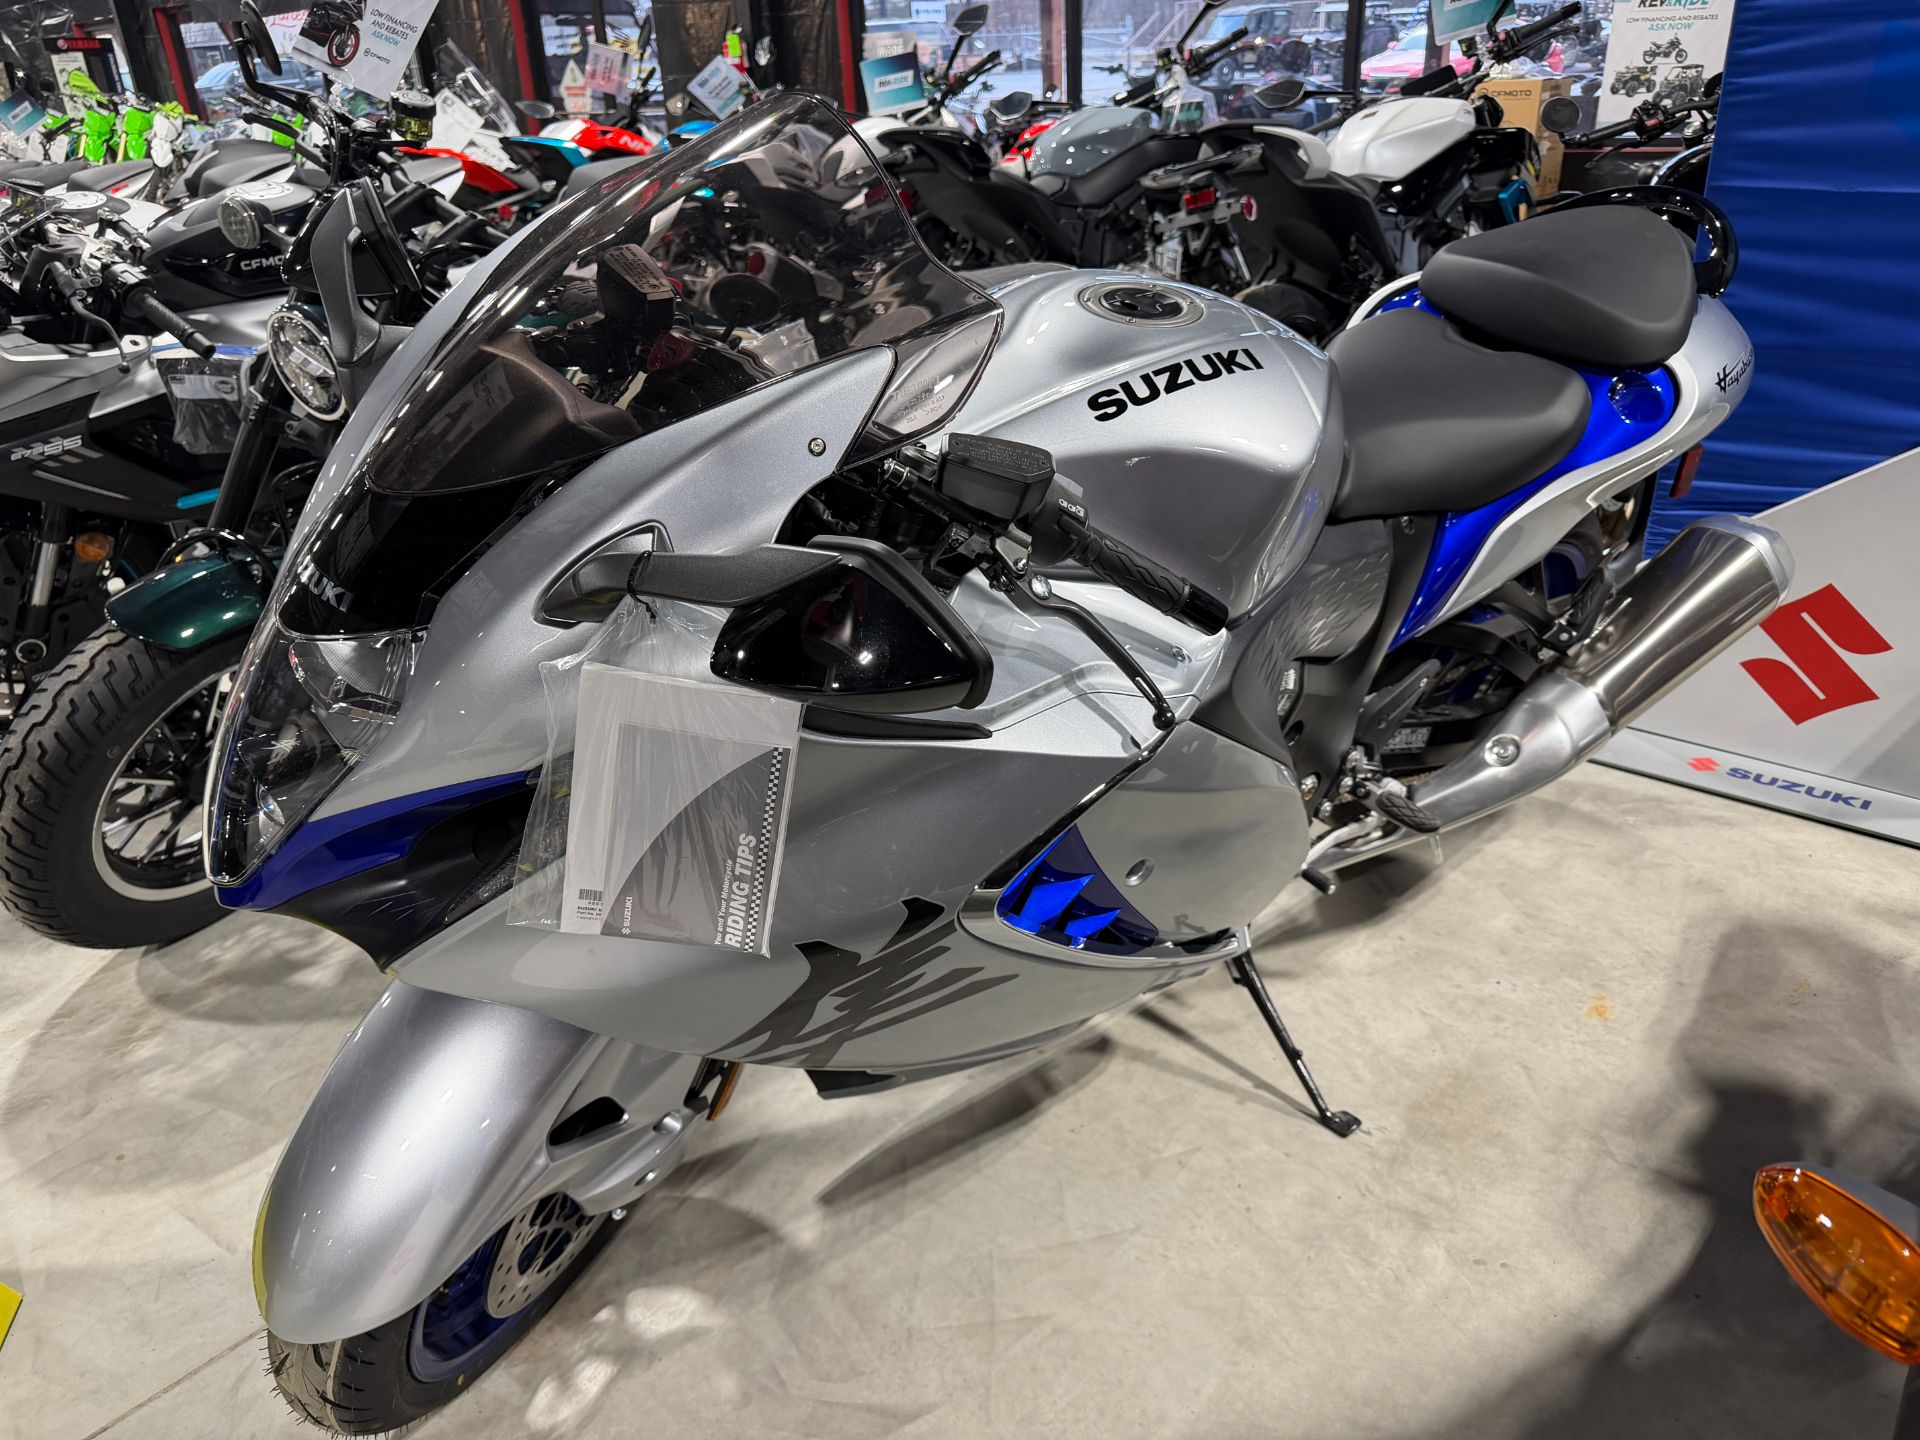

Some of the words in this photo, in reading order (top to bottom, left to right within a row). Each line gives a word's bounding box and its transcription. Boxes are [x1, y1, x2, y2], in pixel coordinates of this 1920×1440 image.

[370, 8, 385, 18] LOW
[385, 14, 418, 33] FINANCING
[371, 20, 385, 29] AND
[385, 25, 409, 40] REBATES
[1648, 23, 1665, 31] ASK
[1667, 22, 1693, 30] NOW
[372, 30, 384, 40] ASK
[385, 35, 401, 46] NOW
[370, 52, 391, 64] CFMOTO
[1490, 89, 1533, 98] CFMOTO
[1086, 348, 1264, 422] SUZUKI
[1725, 766, 1873, 811] SUZUKI
[735, 834, 756, 875] TIPS
[718, 900, 726, 916] Your
[722, 860, 732, 897] Motorcycle
[624, 897, 632, 926] SUZUKI
[725, 881, 749, 947] RIDING
